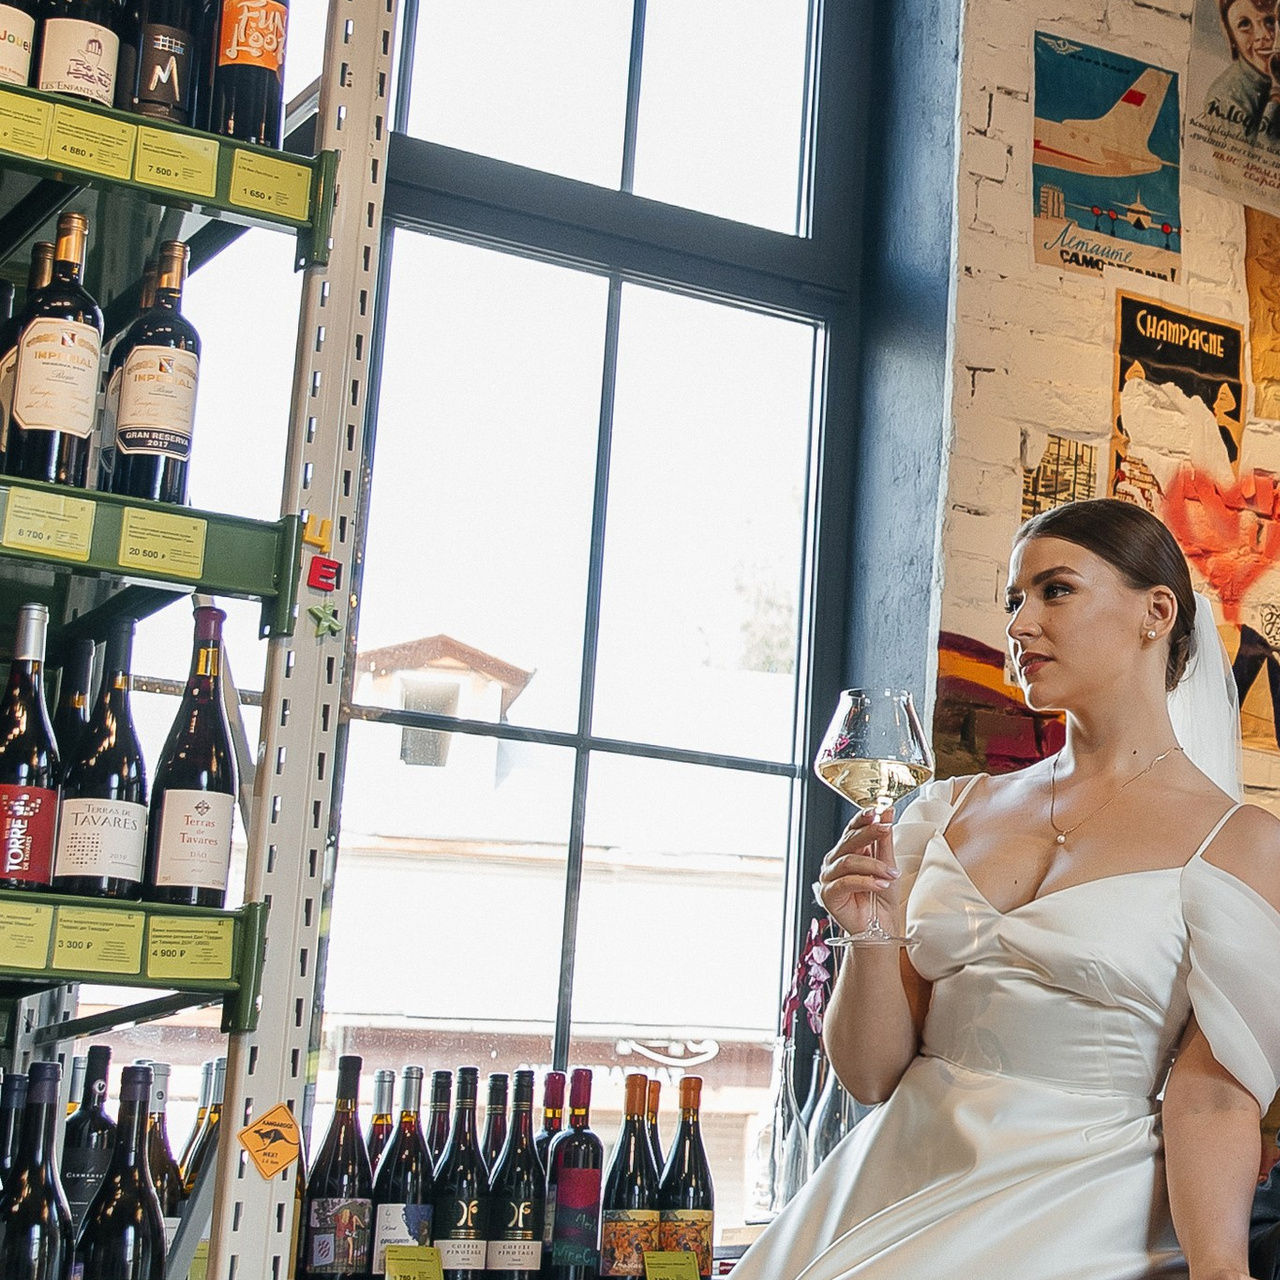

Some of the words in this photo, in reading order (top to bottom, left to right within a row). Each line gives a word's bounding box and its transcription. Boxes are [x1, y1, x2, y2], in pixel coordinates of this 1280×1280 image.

[149, 56, 179, 102] M
[156, 167, 172, 177] 500
[1043, 221, 1134, 263] Летайте
[1136, 310, 1225, 358] CHAMPAGNE
[34, 350, 93, 368] IMPERIAL
[134, 373, 193, 390] IMPERIAL
[126, 431, 150, 440] GRAN
[152, 433, 190, 447] RESERVA
[147, 439, 169, 448] 2017
[142, 550, 159, 558] 500
[85, 803, 119, 815] TERRAS
[121, 808, 131, 816] DE
[71, 812, 139, 831] TAVARES
[184, 814, 216, 828] Terras
[6, 817, 28, 873] TORRE
[179, 832, 219, 847] Tavares
[66, 941, 83, 949] 300
[86, 941, 93, 950] ₽
[161, 949, 178, 958] 900
[179, 949, 186, 958] ₽
